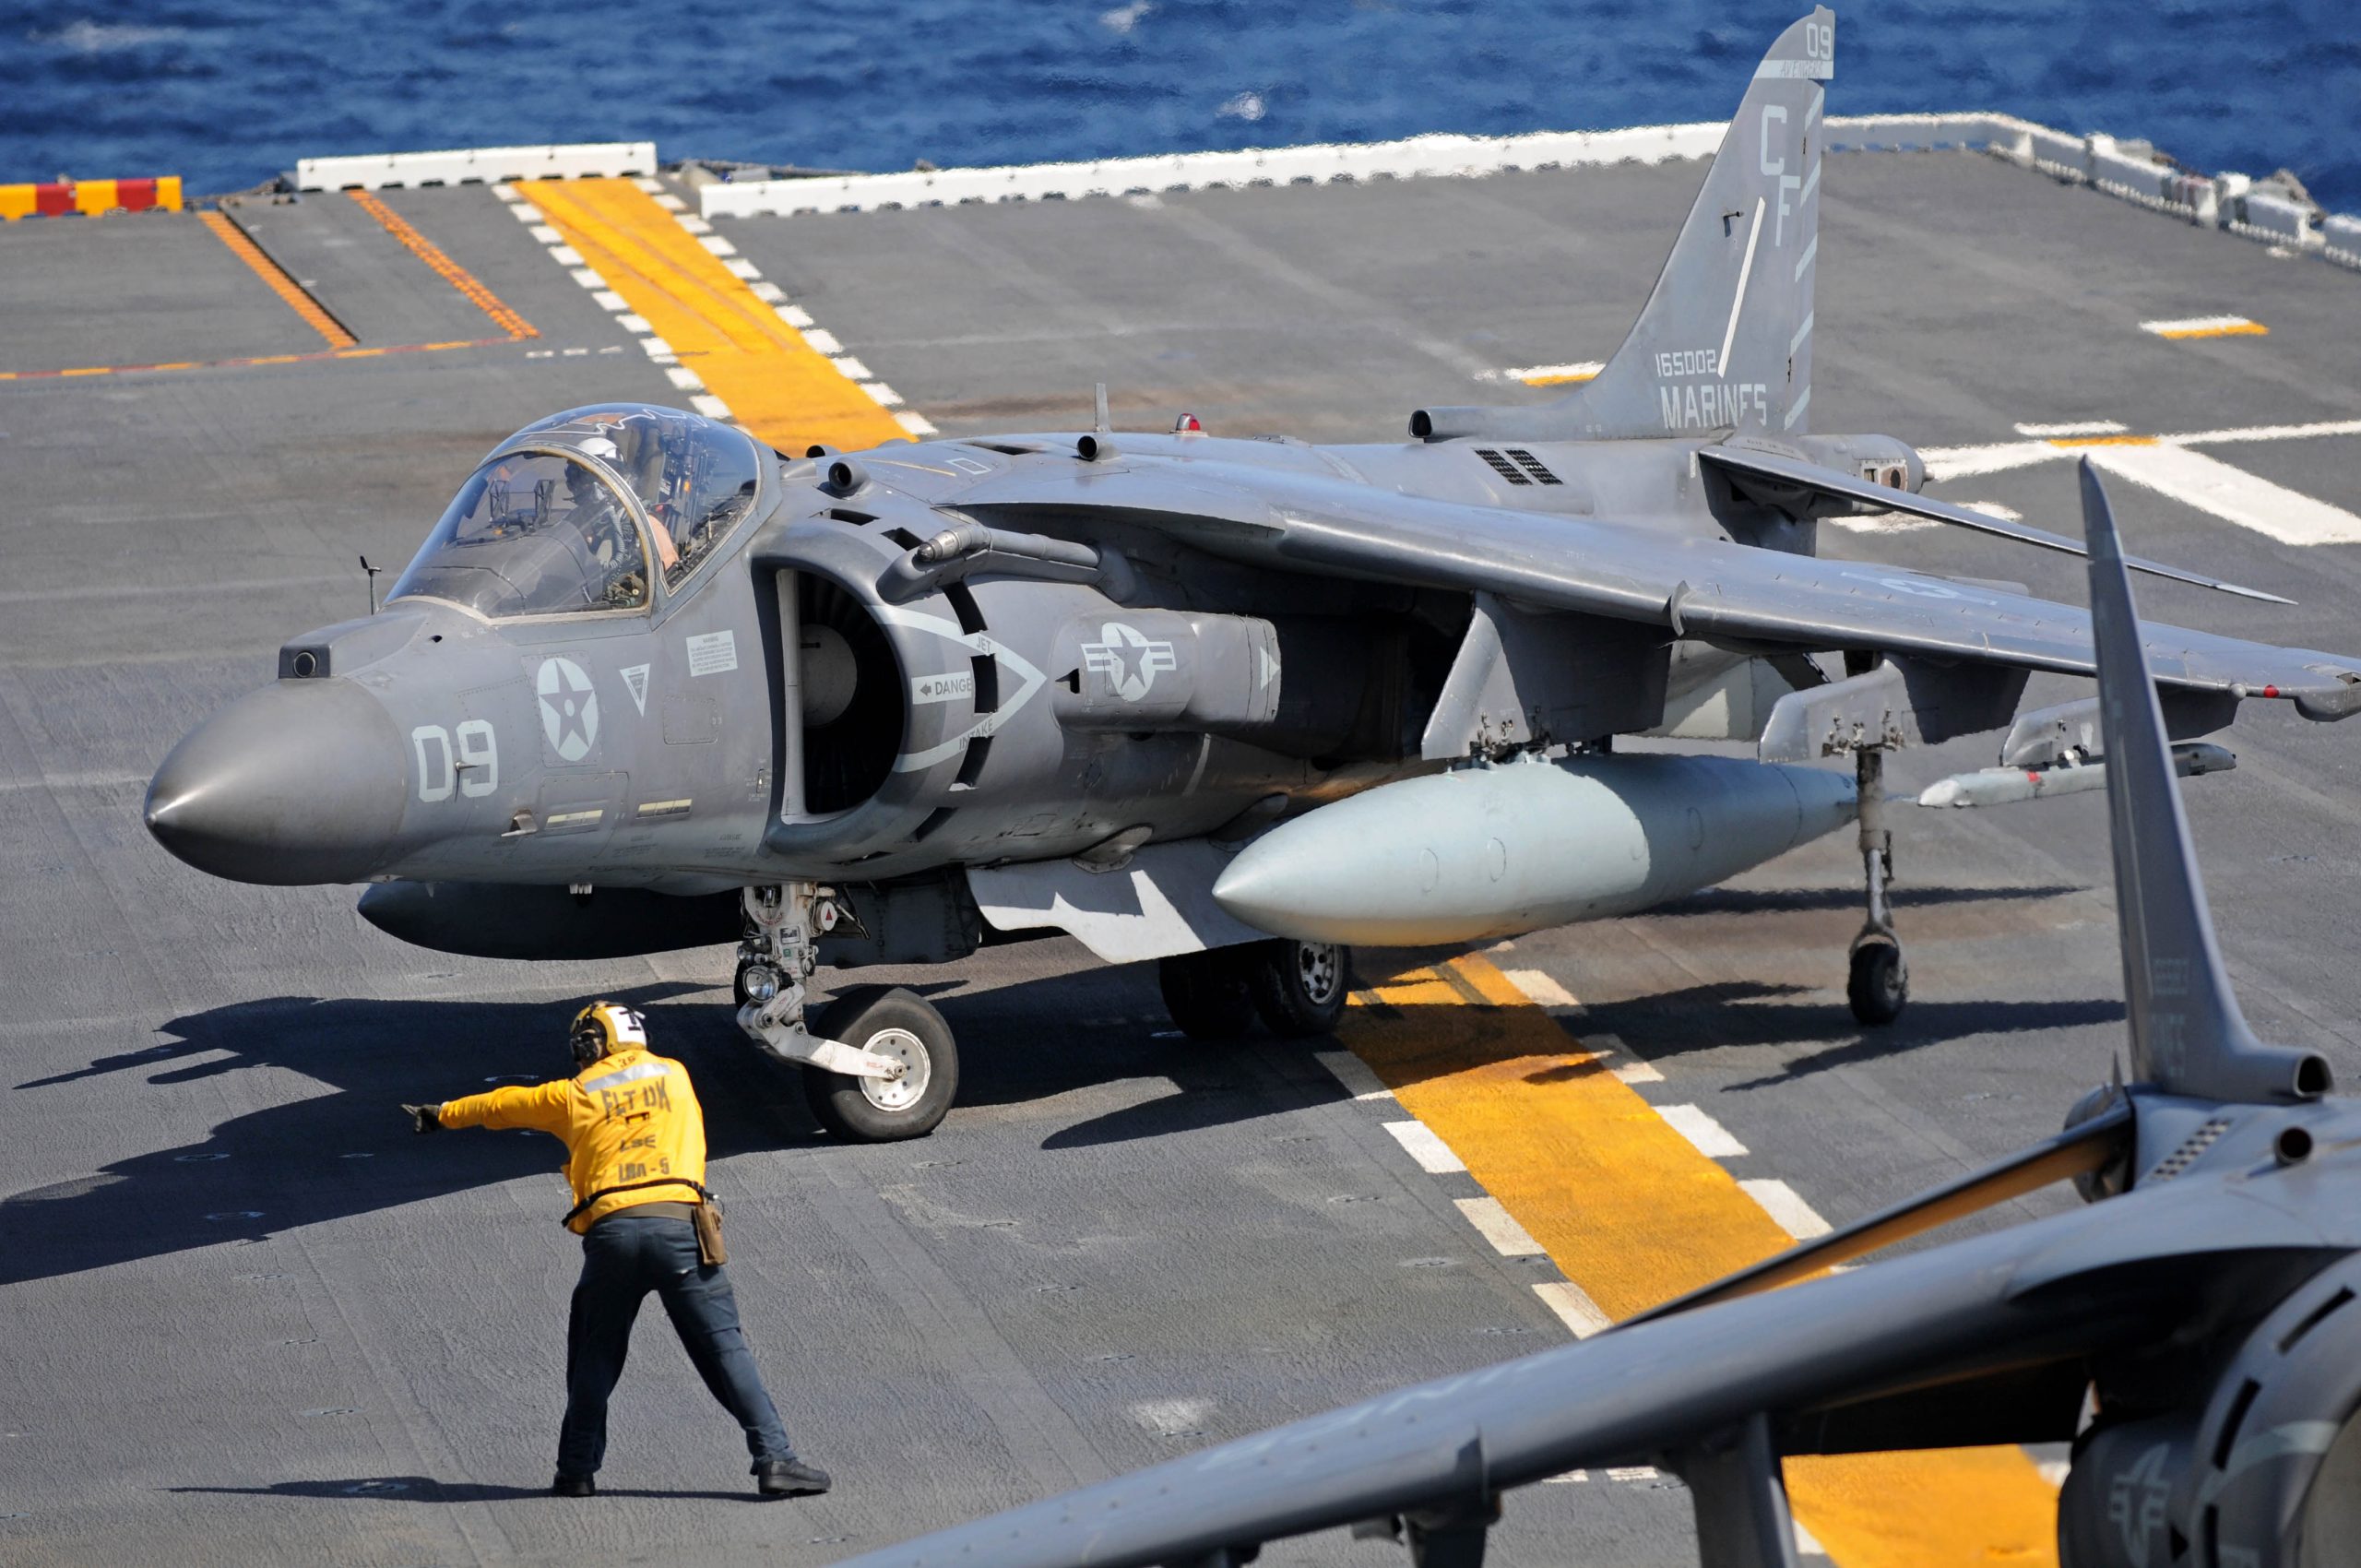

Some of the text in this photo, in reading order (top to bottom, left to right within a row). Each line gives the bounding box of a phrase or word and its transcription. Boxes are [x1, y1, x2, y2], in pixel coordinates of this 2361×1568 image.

[1806, 23, 1832, 61] 09
[1655, 349, 1717, 377] 165002
[1660, 384, 1767, 429] MARINES
[977, 636, 991, 653] JET
[934, 677, 973, 695] DANGE
[411, 719, 498, 802] 09
